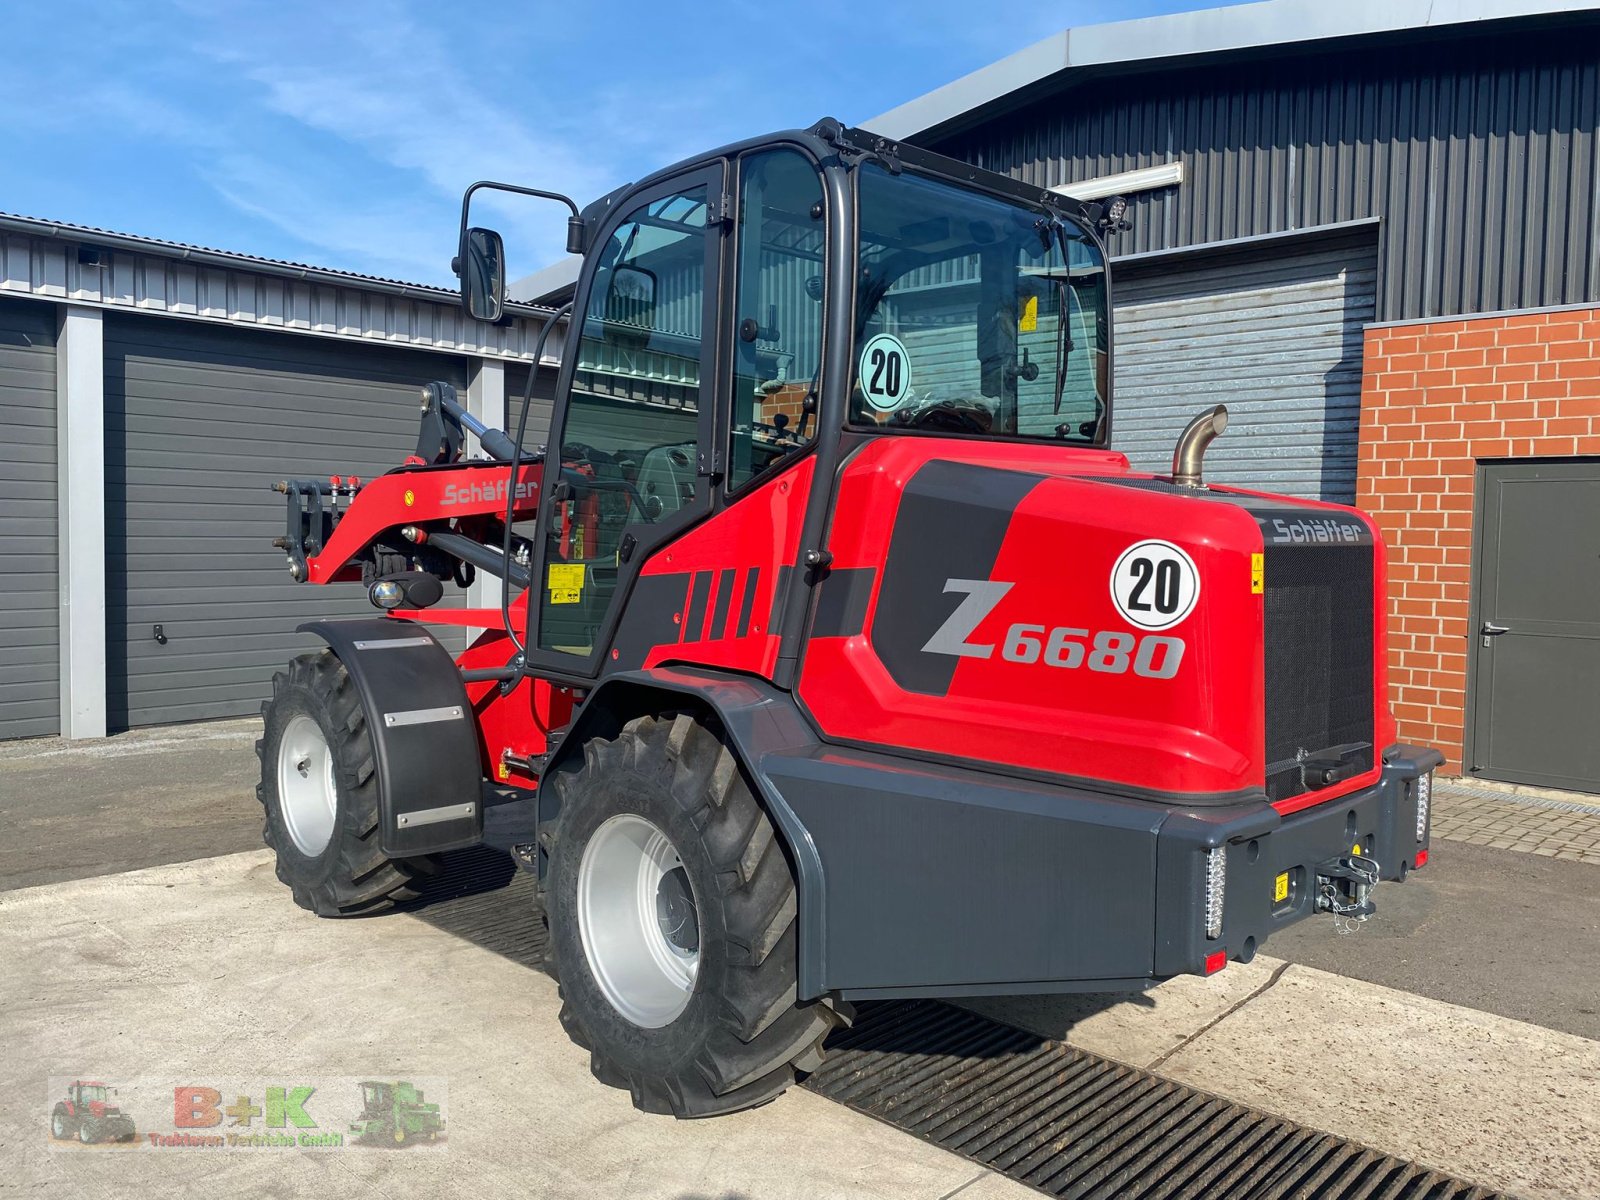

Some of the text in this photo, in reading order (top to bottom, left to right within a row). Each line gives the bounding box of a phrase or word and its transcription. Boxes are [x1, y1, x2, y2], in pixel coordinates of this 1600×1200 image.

[869, 348, 901, 398] 20
[1273, 518, 1363, 543] Schäffer
[1127, 557, 1182, 615] 20
